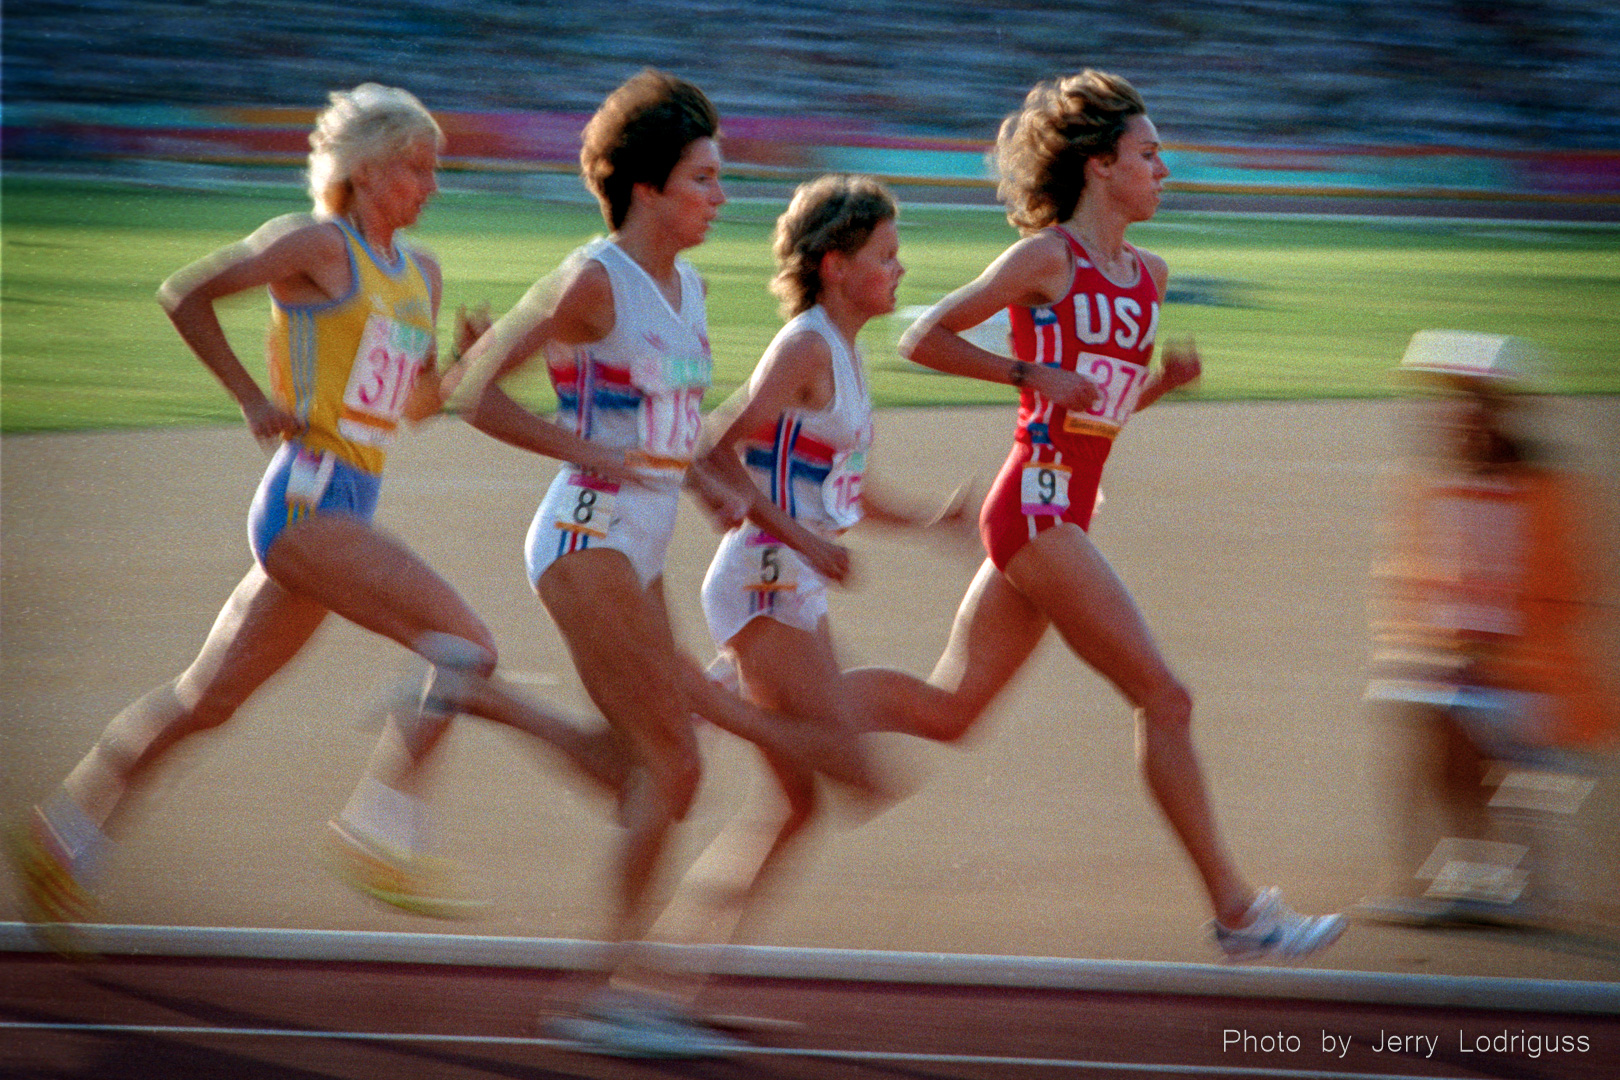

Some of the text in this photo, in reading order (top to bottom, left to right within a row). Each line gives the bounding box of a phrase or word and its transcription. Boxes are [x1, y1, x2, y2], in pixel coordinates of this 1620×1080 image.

[1086, 358, 1147, 421] 37
[1038, 468, 1056, 505] 9
[573, 488, 597, 524] 8
[760, 547, 780, 583] 5
